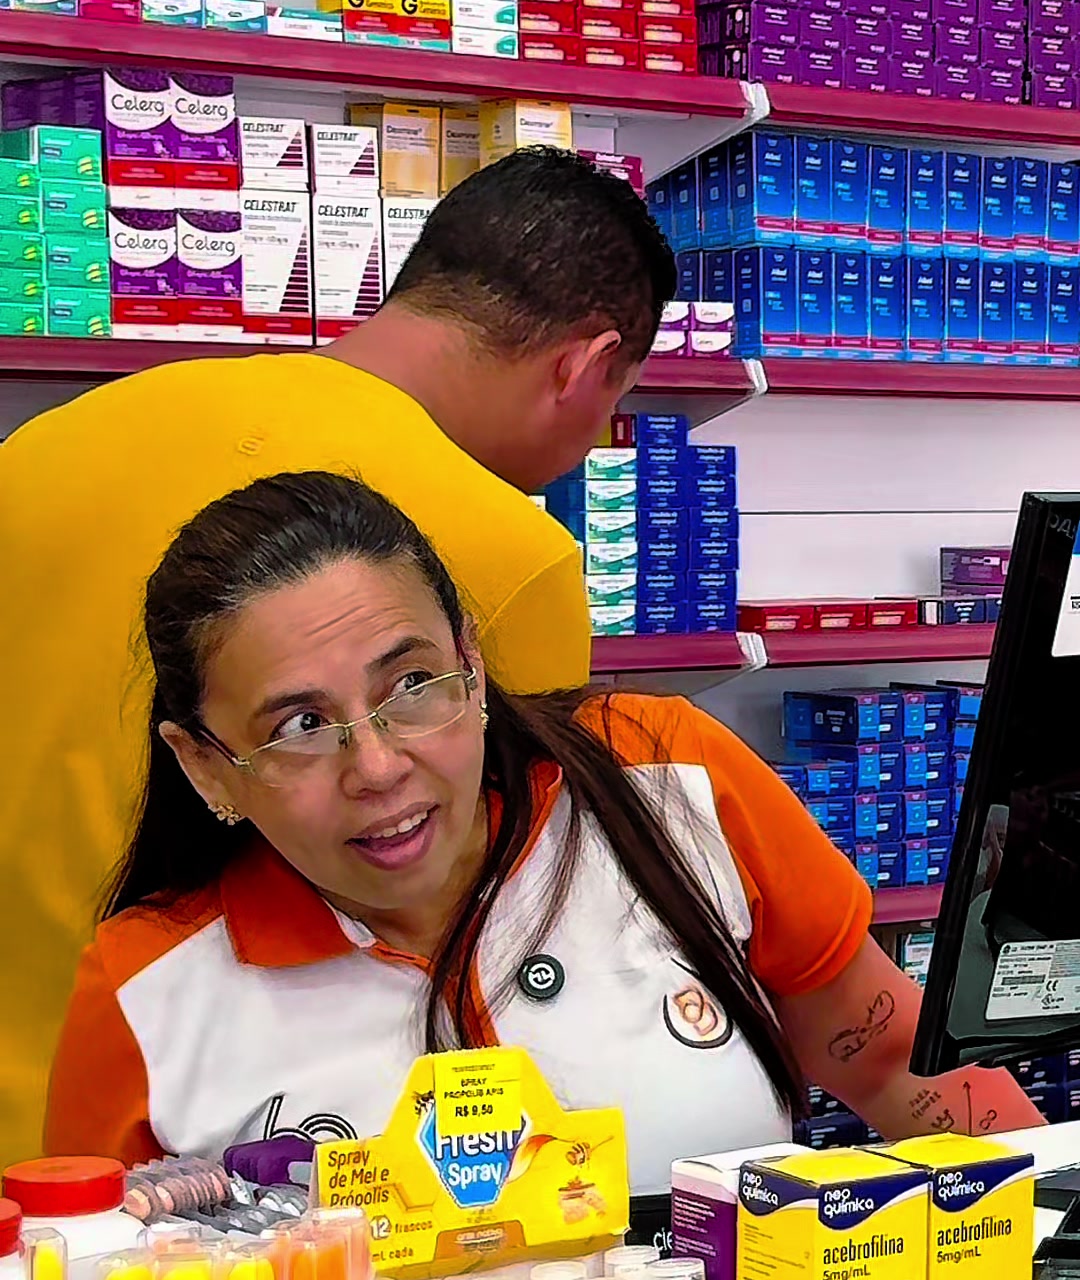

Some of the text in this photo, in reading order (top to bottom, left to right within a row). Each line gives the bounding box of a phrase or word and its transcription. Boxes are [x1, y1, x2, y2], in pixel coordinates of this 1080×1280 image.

[111, 94, 165, 116] Celerg
[174, 97, 228, 120] Celerg
[243, 199, 298, 214] CELESTRAT
[318, 205, 371, 218] CELESTRAT
[114, 232, 169, 254] Celerg
[181, 233, 236, 258] Celerg
[455, 1105, 469, 1117] R$
[327, 1148, 371, 1173] Spray
[328, 1167, 390, 1190] de Mel e
[448, 1161, 503, 1190] Spray
[742, 1170, 764, 1188] neo
[937, 1169, 965, 1189] neo
[741, 1185, 779, 1207] química
[824, 1187, 851, 1203] neo
[937, 1179, 986, 1200] química
[823, 1197, 875, 1219] química
[371, 1217, 390, 1239] 12
[935, 1214, 1013, 1249] acebrofilina
[388, 1246, 415, 1260] cada
[822, 1234, 905, 1265] acebrofilina
[936, 1245, 982, 1264] 5mg/mL
